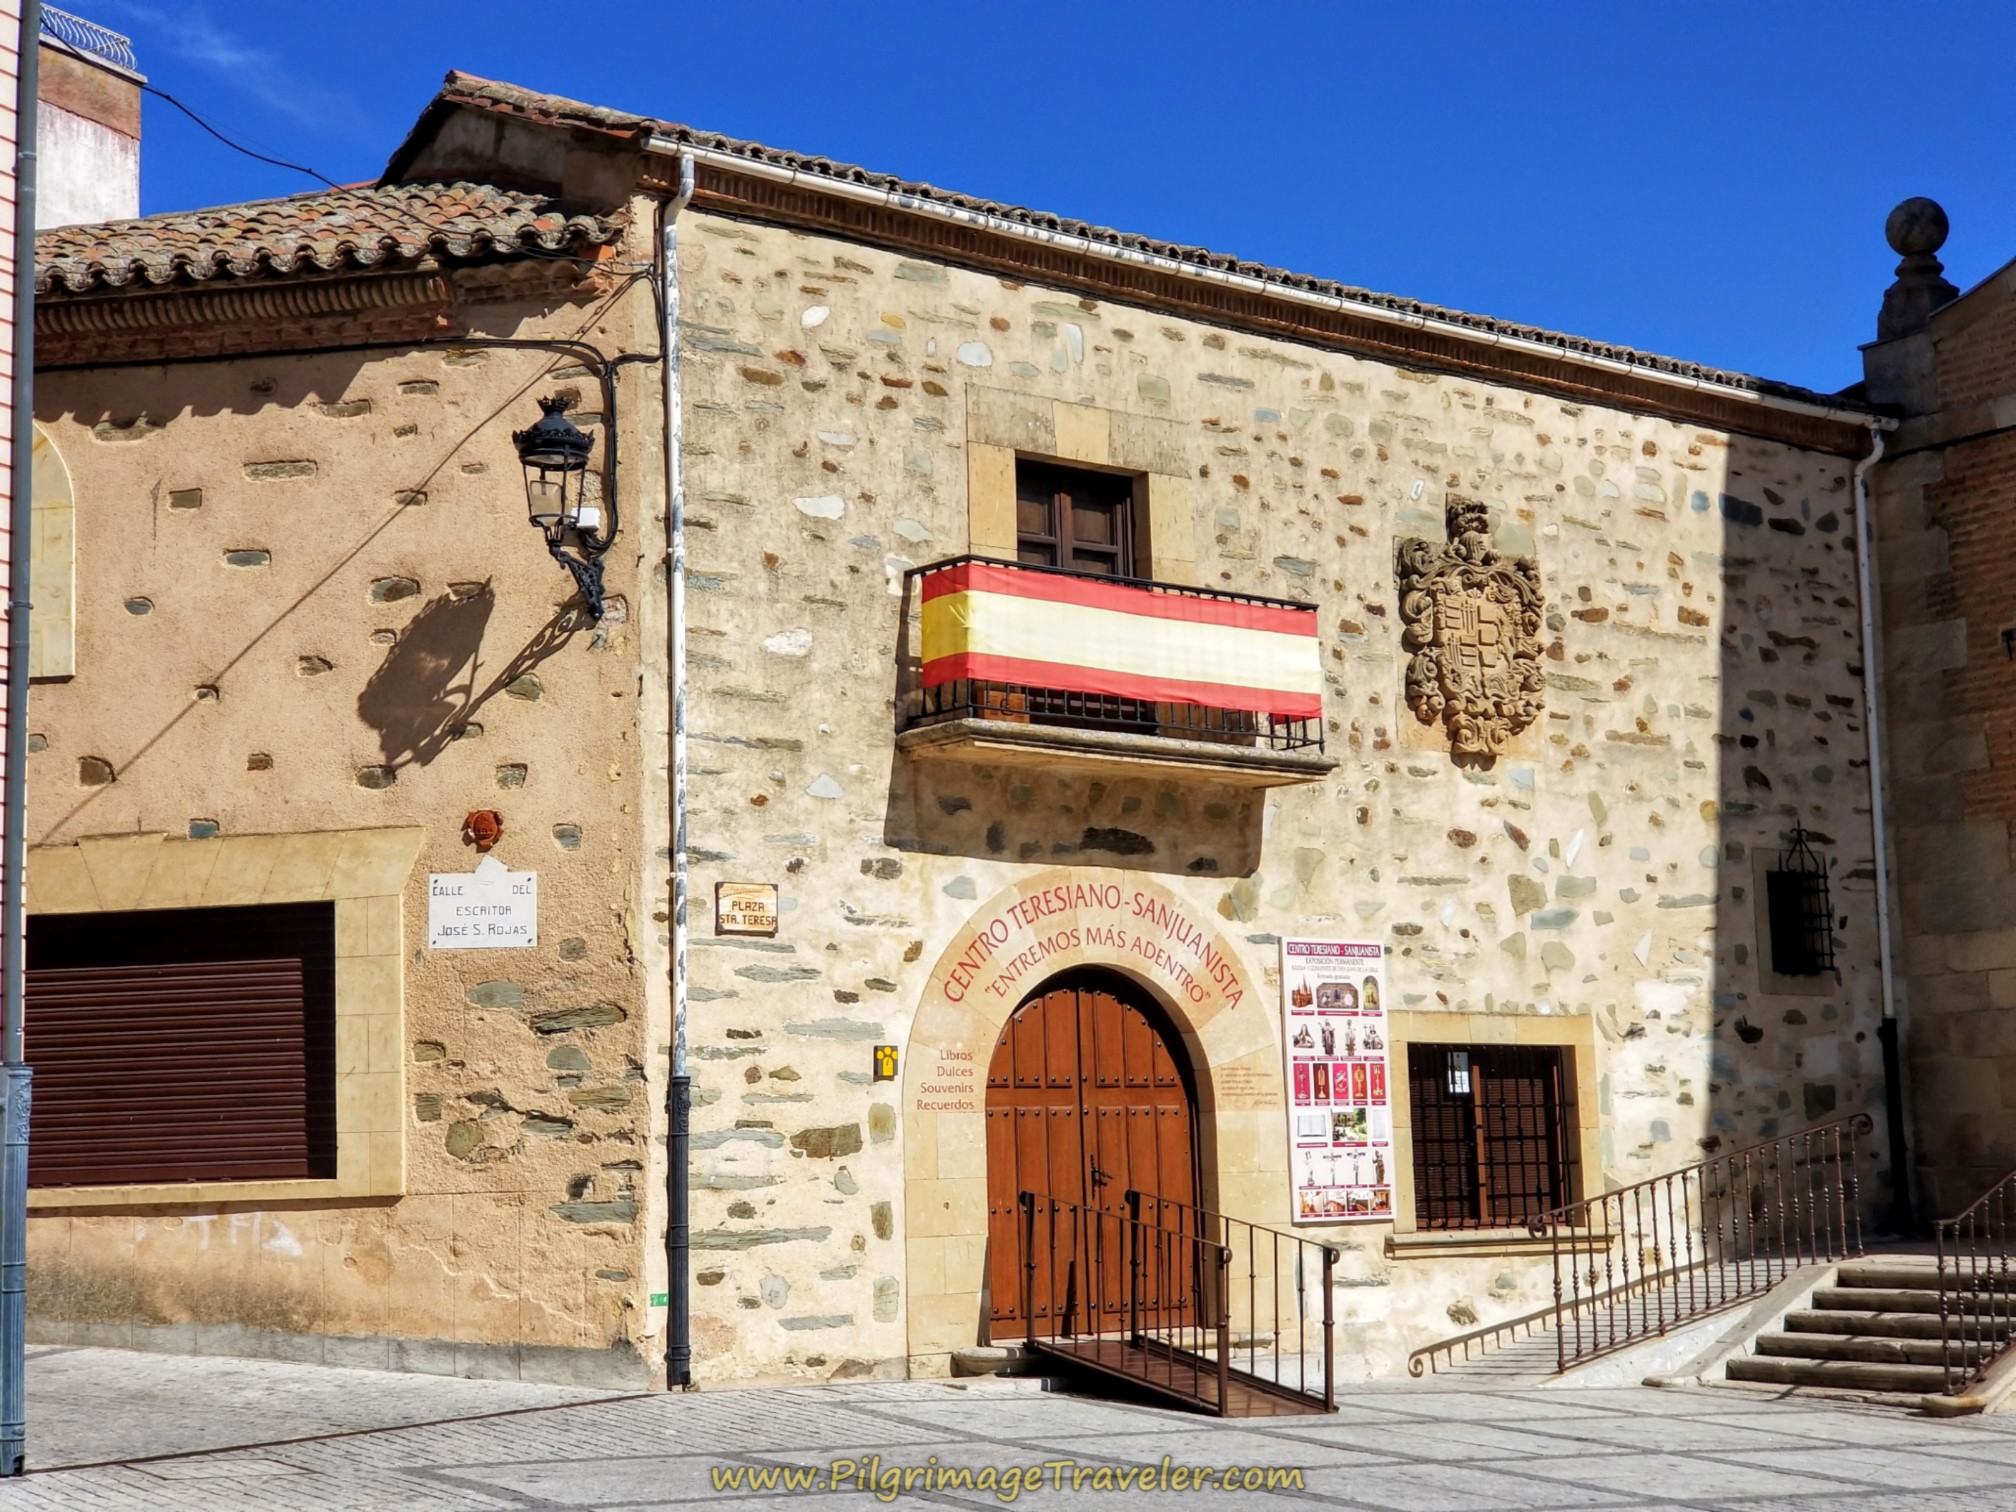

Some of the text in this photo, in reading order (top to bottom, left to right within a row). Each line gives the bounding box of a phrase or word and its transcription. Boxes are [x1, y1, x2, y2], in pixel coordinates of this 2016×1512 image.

[432, 885, 532, 896] CALLE DEL
[456, 905, 512, 916] ESCRITOR
[732, 900, 765, 912] PLAZA
[719, 914, 778, 926] STA. TERESA
[437, 923, 528, 936] JOSÉ S. ROJAS
[1086, 923, 1127, 949] MÁS
[1288, 943, 1310, 955] CENTRO
[1311, 944, 1340, 956] TERESIANO
[1344, 946, 1380, 958] SANJUANISTA
[943, 918, 1009, 1003] CENTRO
[940, 1049, 973, 1061] Libros
[937, 1066, 974, 1077] Dulces
[920, 1082, 974, 1094] Souvenirs
[916, 1099, 975, 1111] Recuerdos
